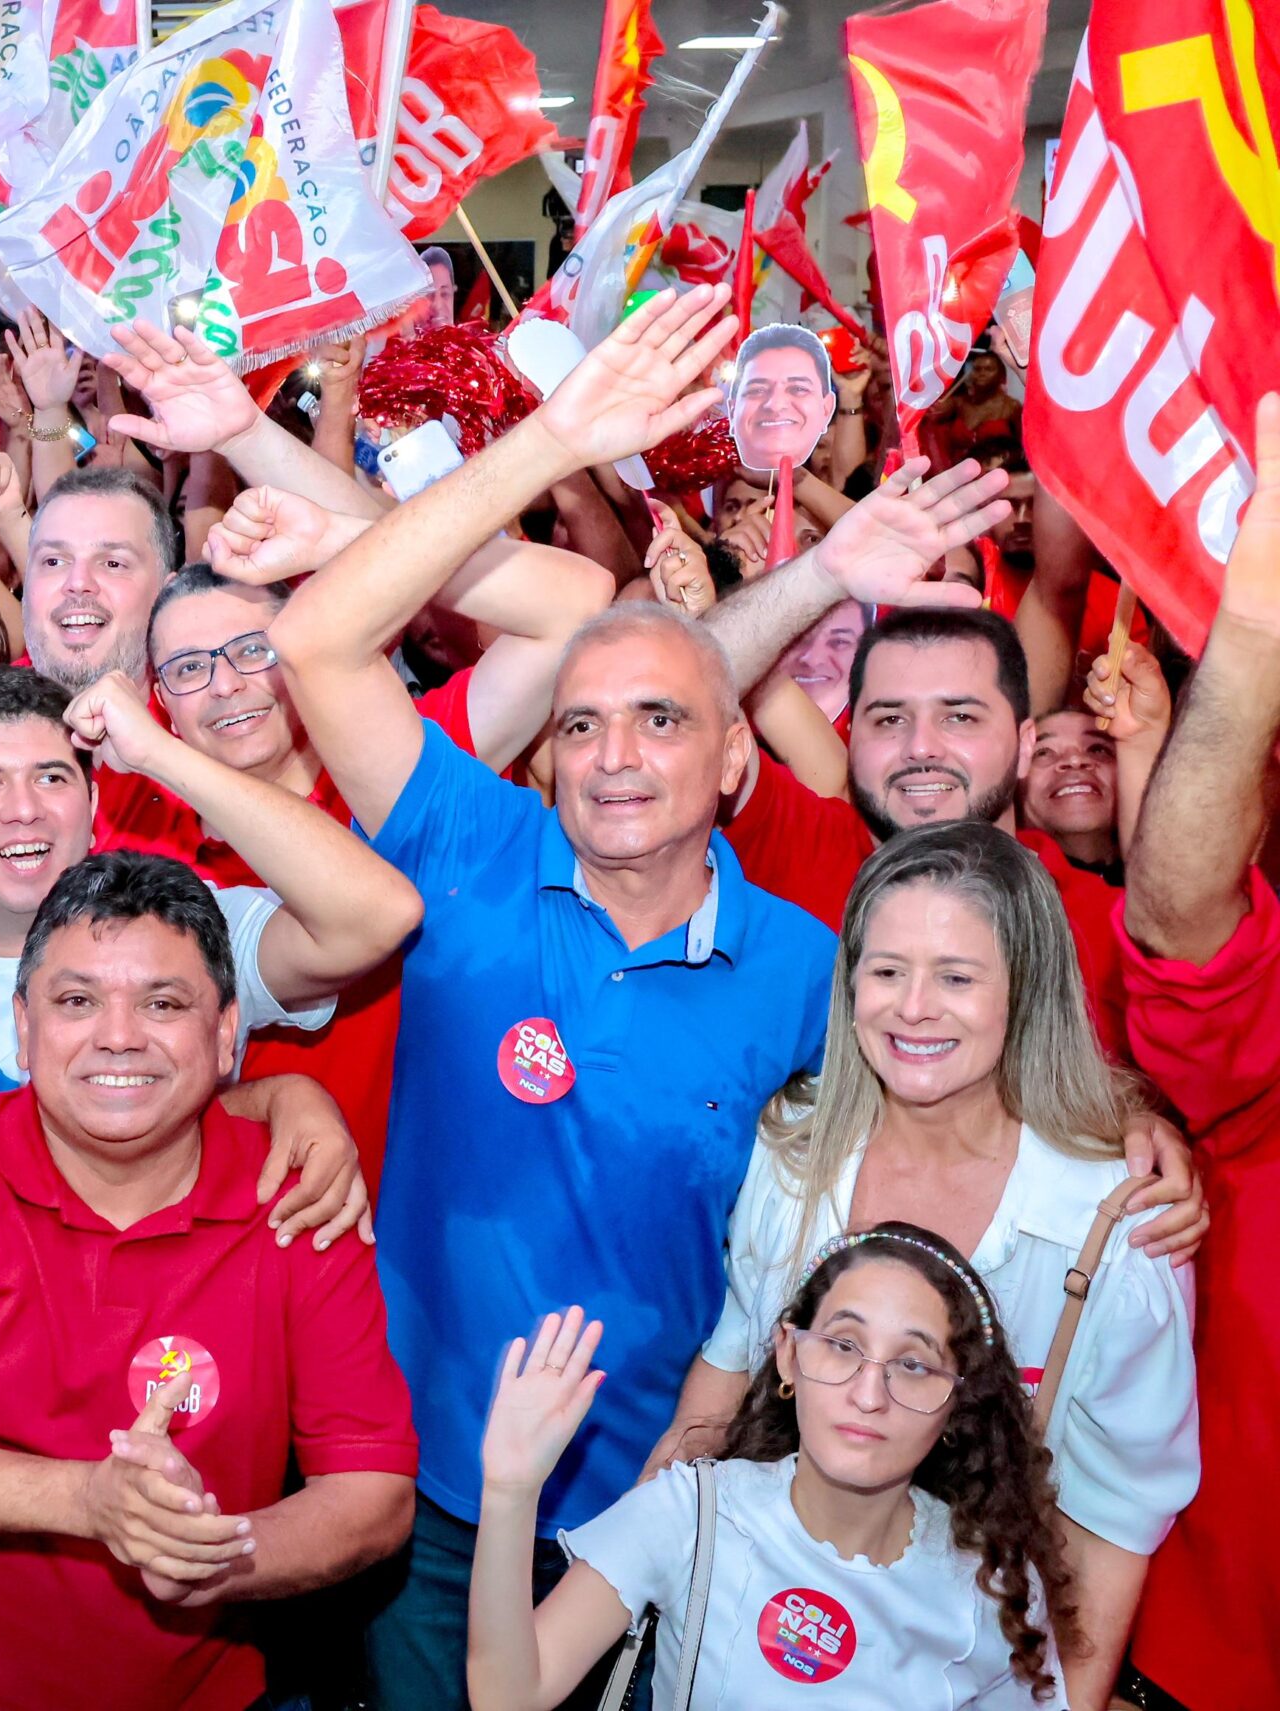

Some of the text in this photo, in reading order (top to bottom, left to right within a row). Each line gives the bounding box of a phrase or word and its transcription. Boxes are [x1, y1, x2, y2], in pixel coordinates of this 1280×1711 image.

[268, 69, 327, 247] FEDERAÇÃO
[513, 1038, 566, 1077] NAS
[777, 1607, 842, 1655] NAS
[785, 1593, 848, 1639] COLI
[783, 1653, 816, 1677] NOS
